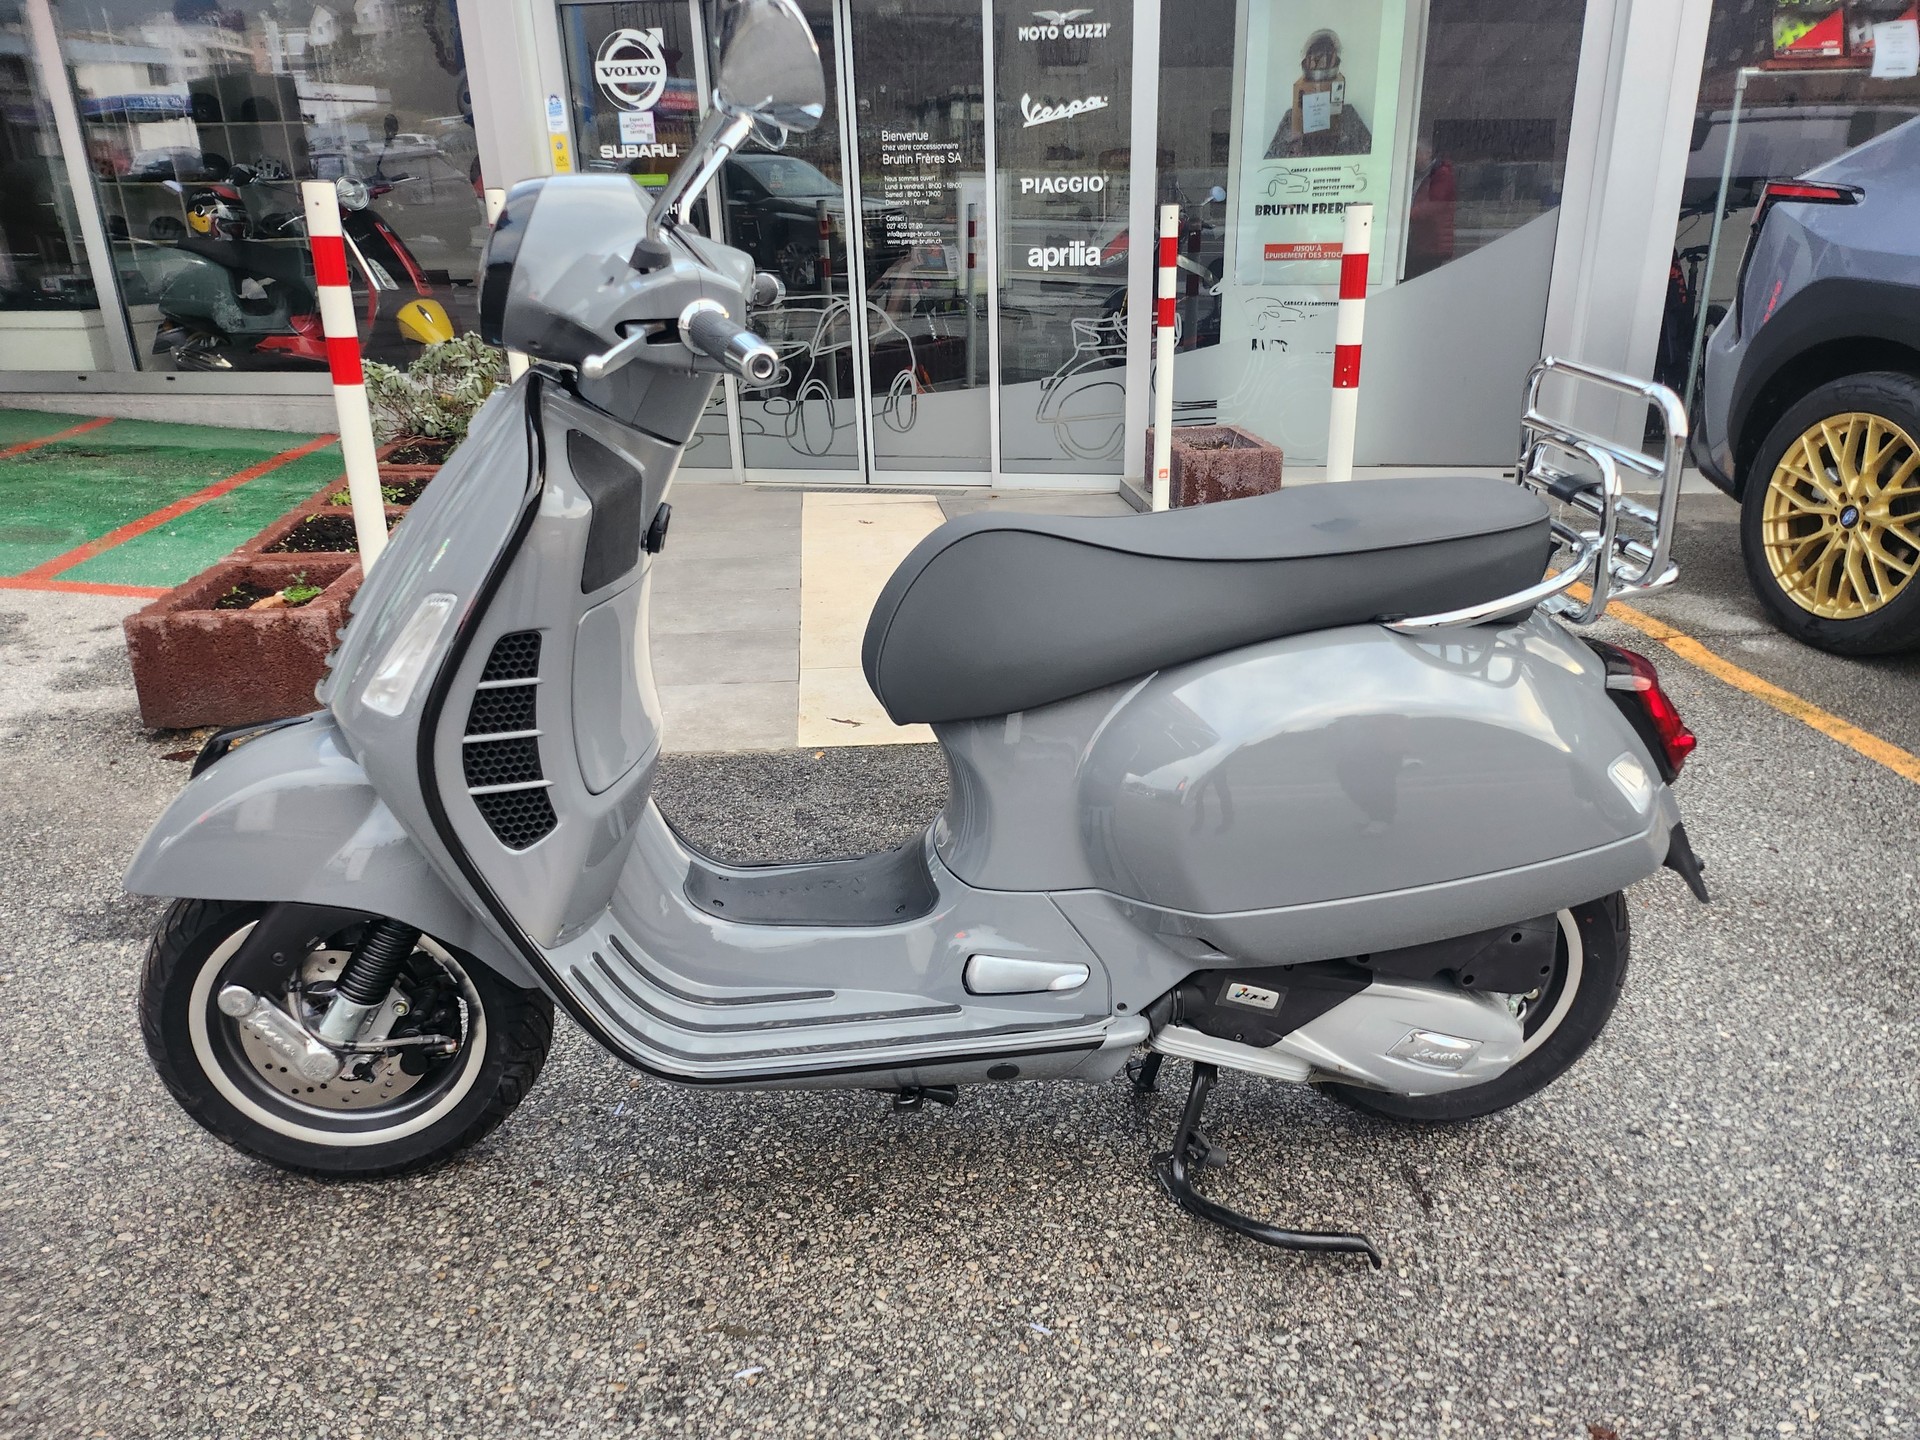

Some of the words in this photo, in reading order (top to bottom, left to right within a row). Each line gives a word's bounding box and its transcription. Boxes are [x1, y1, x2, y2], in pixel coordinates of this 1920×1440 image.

[1018, 25, 1058, 41] MOTO
[600, 66, 661, 77] VOLVO
[1020, 93, 1108, 128] Vespa
[881, 130, 929, 141] Bienvenue
[896, 143, 912, 151] votre
[912, 142, 959, 151] concessionnaire
[882, 153, 913, 165] Bruttin
[915, 152, 946, 164] Frères
[947, 152, 962, 163] SA
[1020, 176, 1104, 194] PIAGGIO
[1255, 203, 1309, 216] BRUTTIN
[1028, 241, 1101, 271] aprilia
[1265, 251, 1307, 259] ÉPUISEMENT
